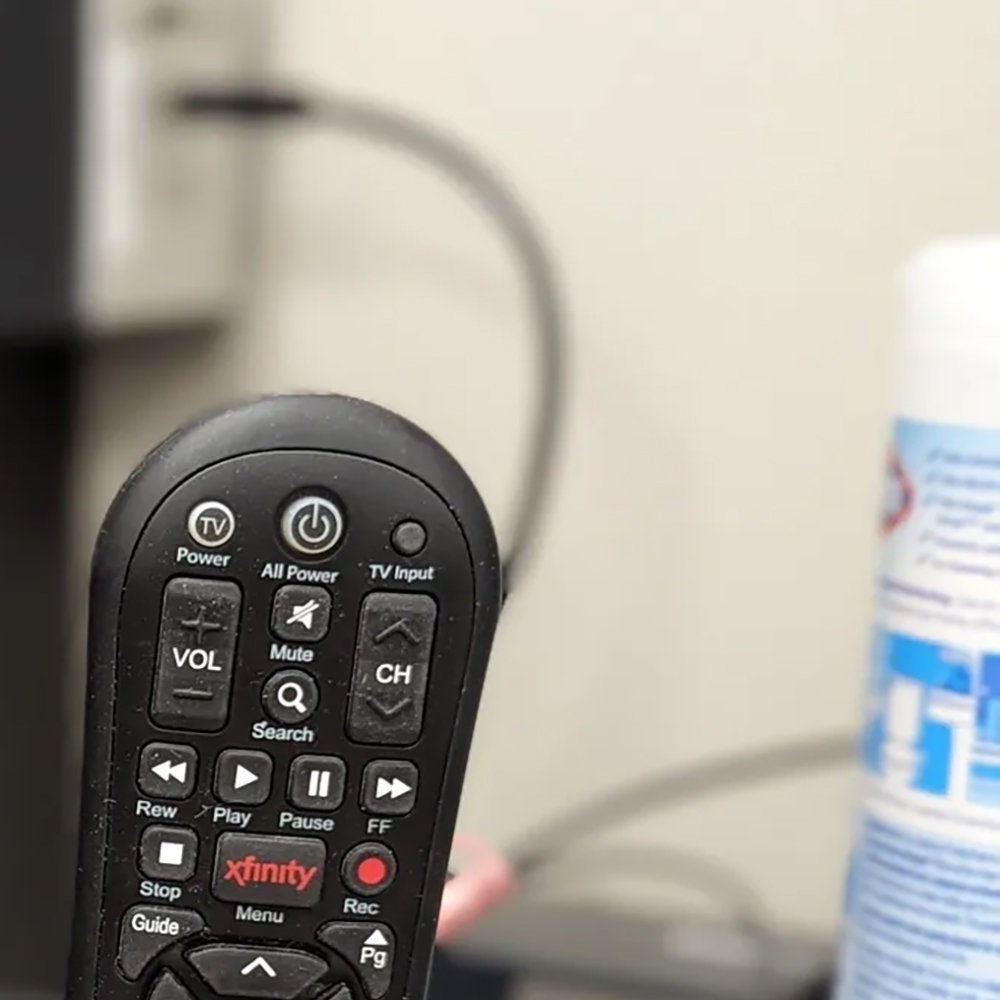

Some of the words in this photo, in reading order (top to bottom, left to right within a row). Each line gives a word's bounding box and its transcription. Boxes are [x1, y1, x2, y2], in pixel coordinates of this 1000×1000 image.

[200, 516, 227, 536] TV
[176, 548, 231, 567] Power
[261, 564, 283, 579] All
[286, 565, 339, 584] Power
[369, 565, 392, 580] TV
[394, 566, 434, 582] Input
[172, 648, 222, 671] VOL
[270, 645, 314, 662] Mute
[375, 664, 411, 684] CH
[252, 722, 314, 742] Search
[136, 801, 178, 819] Rew
[213, 807, 252, 828] Play
[279, 813, 335, 831] Pause
[367, 819, 392, 834] FF
[223, 856, 318, 891] xfinity
[140, 881, 182, 901] Stop
[236, 906, 284, 923] Menu
[343, 899, 380, 915] Rec
[131, 914, 179, 935] Guide
[360, 947, 386, 969] Pg
